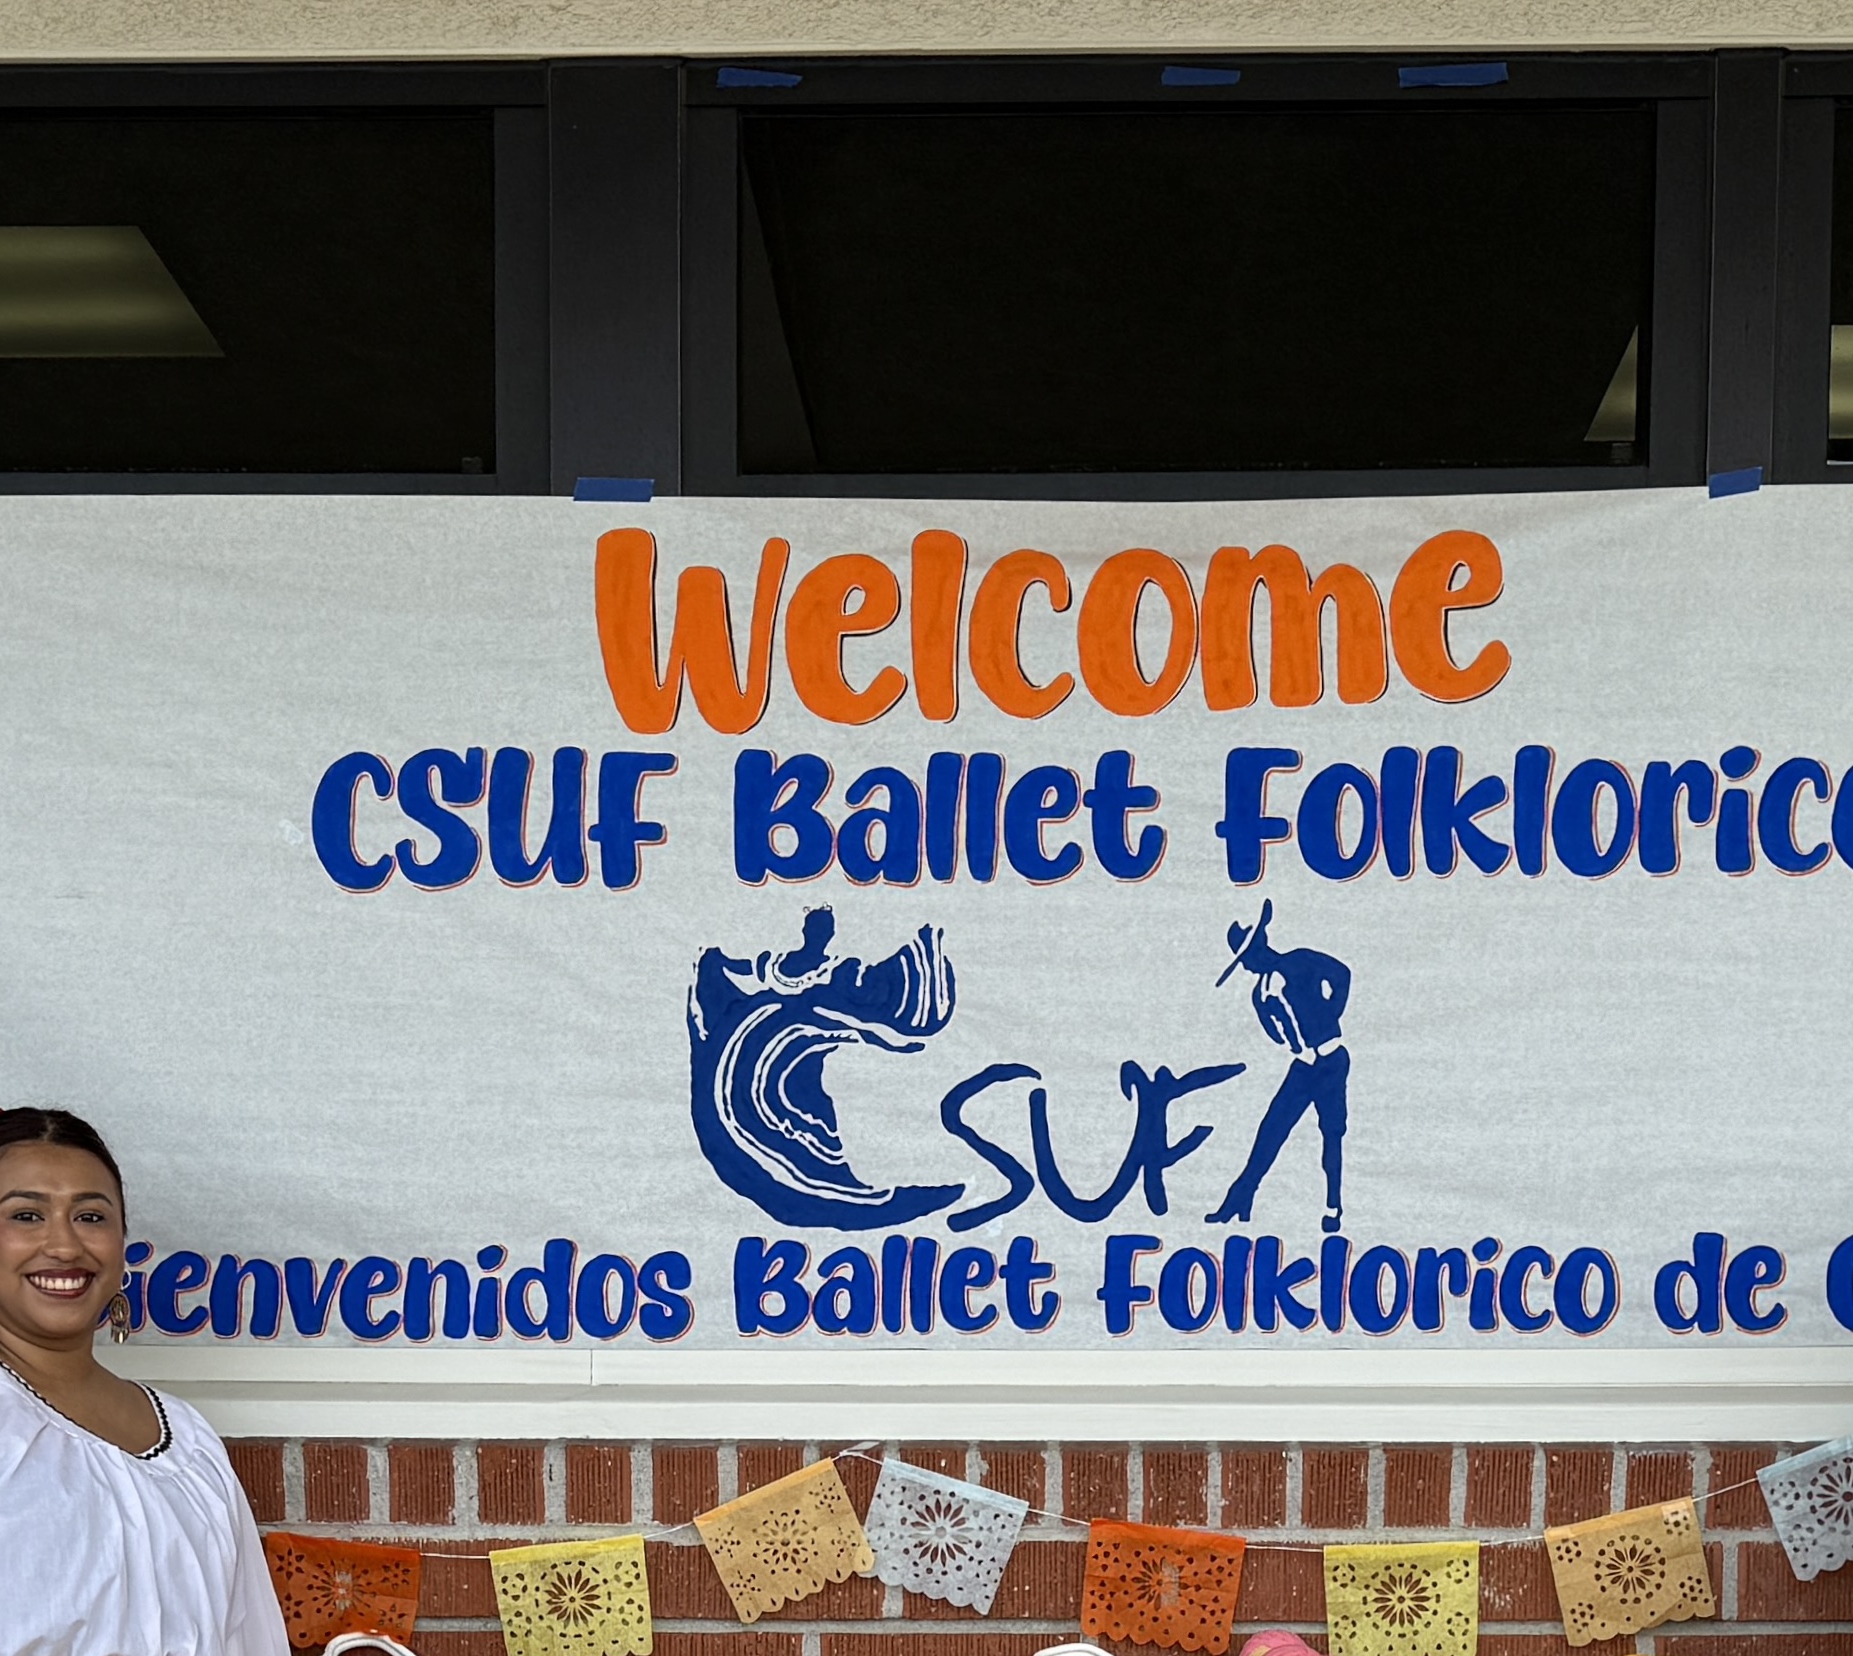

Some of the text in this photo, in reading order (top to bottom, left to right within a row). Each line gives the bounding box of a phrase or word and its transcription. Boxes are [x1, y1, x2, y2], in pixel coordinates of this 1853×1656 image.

[594, 527, 1513, 734] Welcome
[311, 746, 679, 892] CSUF
[733, 746, 1166, 887] Ballet
[96, 1238, 694, 1343] ienvenidos
[733, 1235, 1061, 1337] Ballet
[1096, 1234, 1618, 1335] Folklorico
[1654, 1231, 1787, 1334] de
